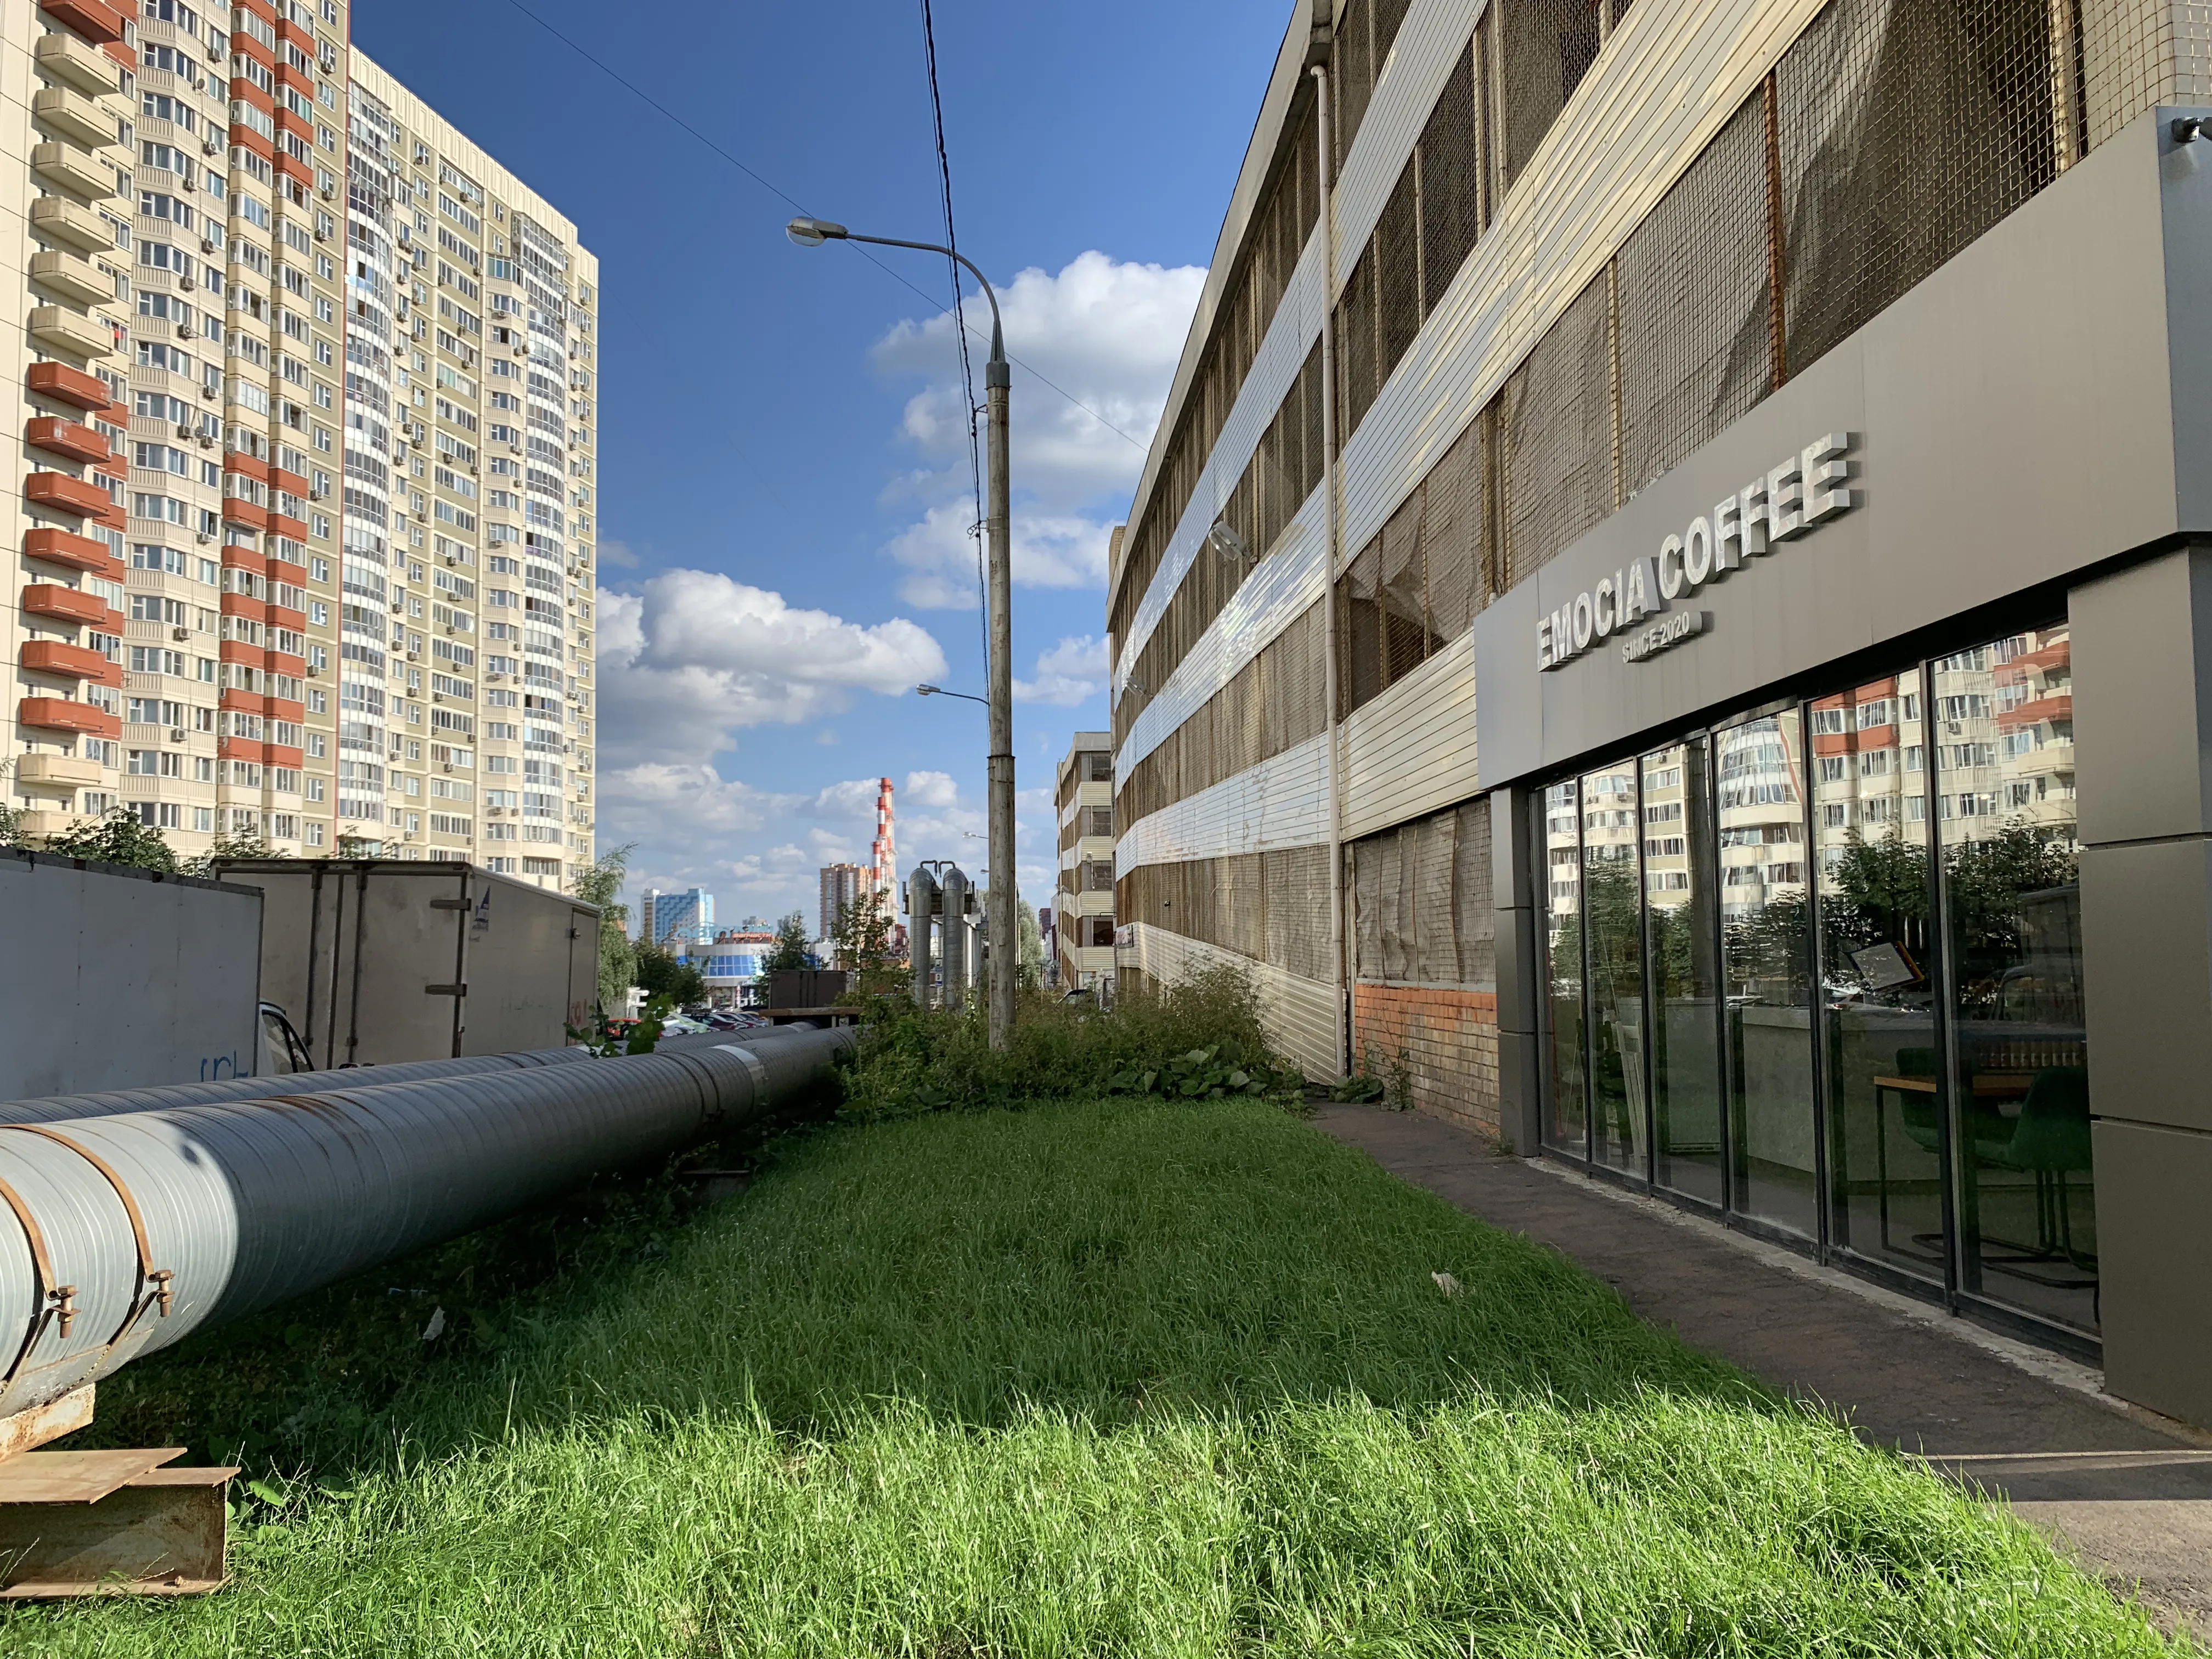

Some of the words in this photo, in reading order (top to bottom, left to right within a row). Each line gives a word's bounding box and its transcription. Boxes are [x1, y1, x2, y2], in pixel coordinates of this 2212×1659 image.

[1537, 556, 1656, 672] EMOCIA
[1658, 432, 1849, 600] COFFEE
[1622, 627, 1658, 663] SINCE
[1660, 611, 1693, 646] 2020
